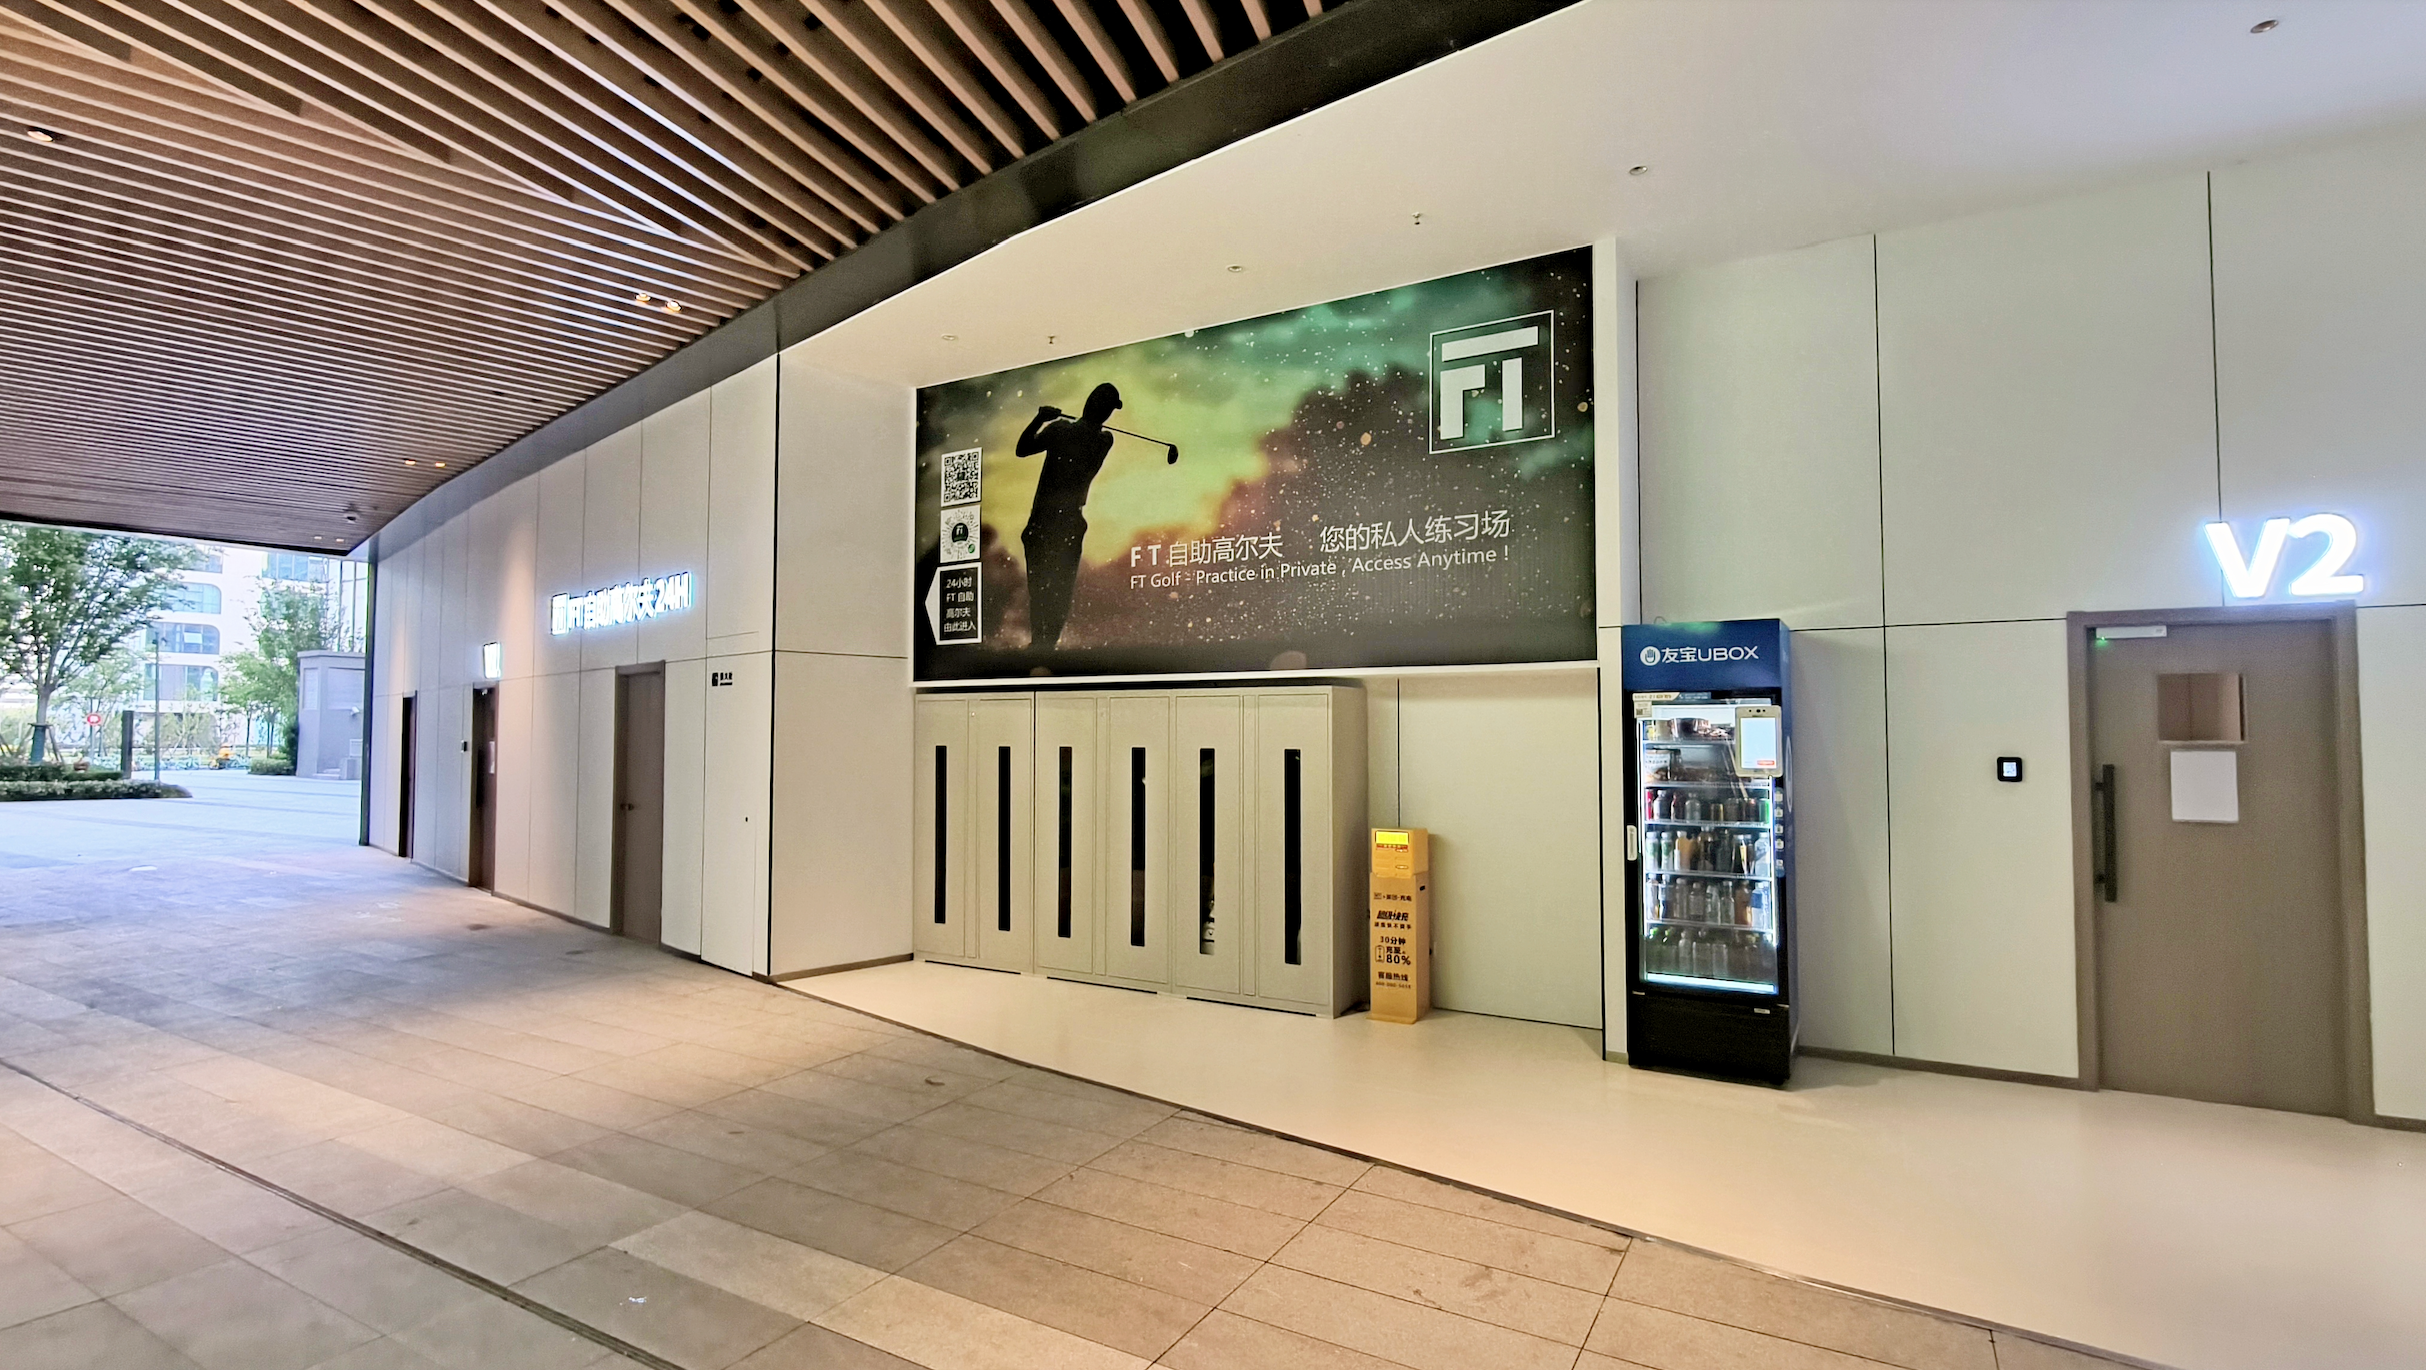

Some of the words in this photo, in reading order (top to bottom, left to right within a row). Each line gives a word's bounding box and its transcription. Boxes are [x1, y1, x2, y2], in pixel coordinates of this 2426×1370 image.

[1169, 532, 1284, 568] 自助高尔夫
[1320, 510, 1511, 552] 您的私人练习场
[2204, 513, 2365, 598] V2
[1130, 574, 1147, 589] FT
[1151, 571, 1181, 588] Golf
[1196, 567, 1256, 585] Practice
[1261, 564, 1275, 579] in
[1352, 556, 1412, 573] Access
[946, 576, 973, 589] 24小时
[946, 592, 956, 603] FT
[957, 590, 975, 603] 自助
[946, 606, 972, 619] 高尔夫
[943, 620, 977, 633] 由此进入
[1386, 954, 1411, 966] 80%
